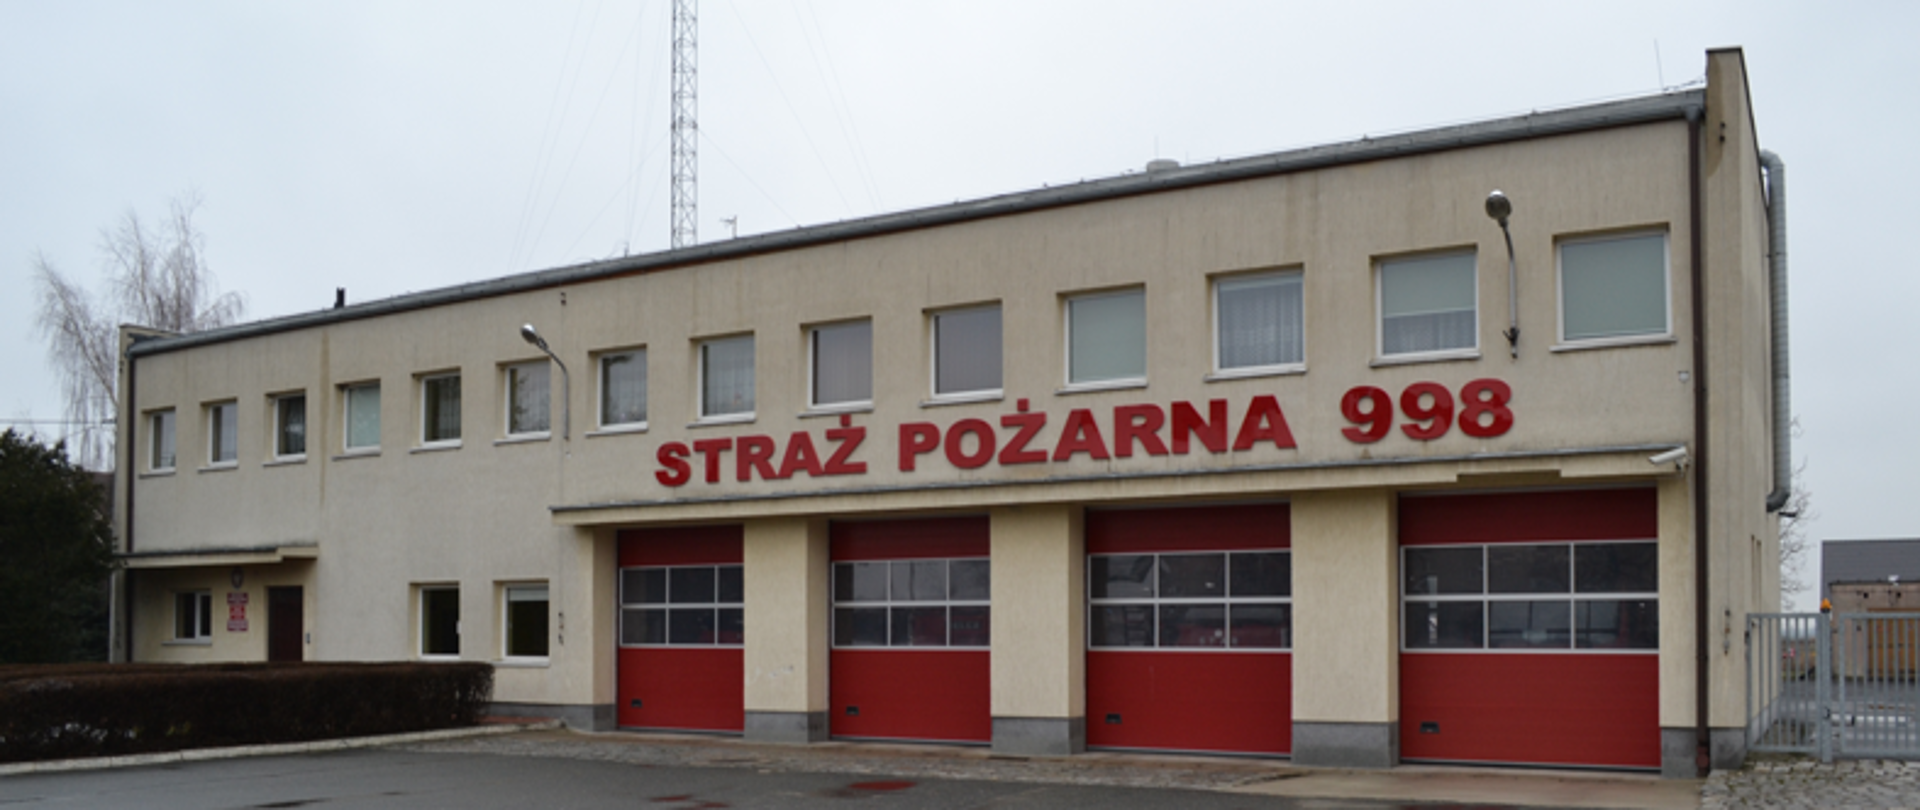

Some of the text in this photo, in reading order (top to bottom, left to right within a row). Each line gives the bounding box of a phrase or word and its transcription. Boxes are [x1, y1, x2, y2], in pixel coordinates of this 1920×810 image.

[655, 378, 1514, 488] STRAŻ POŻARNA 998
